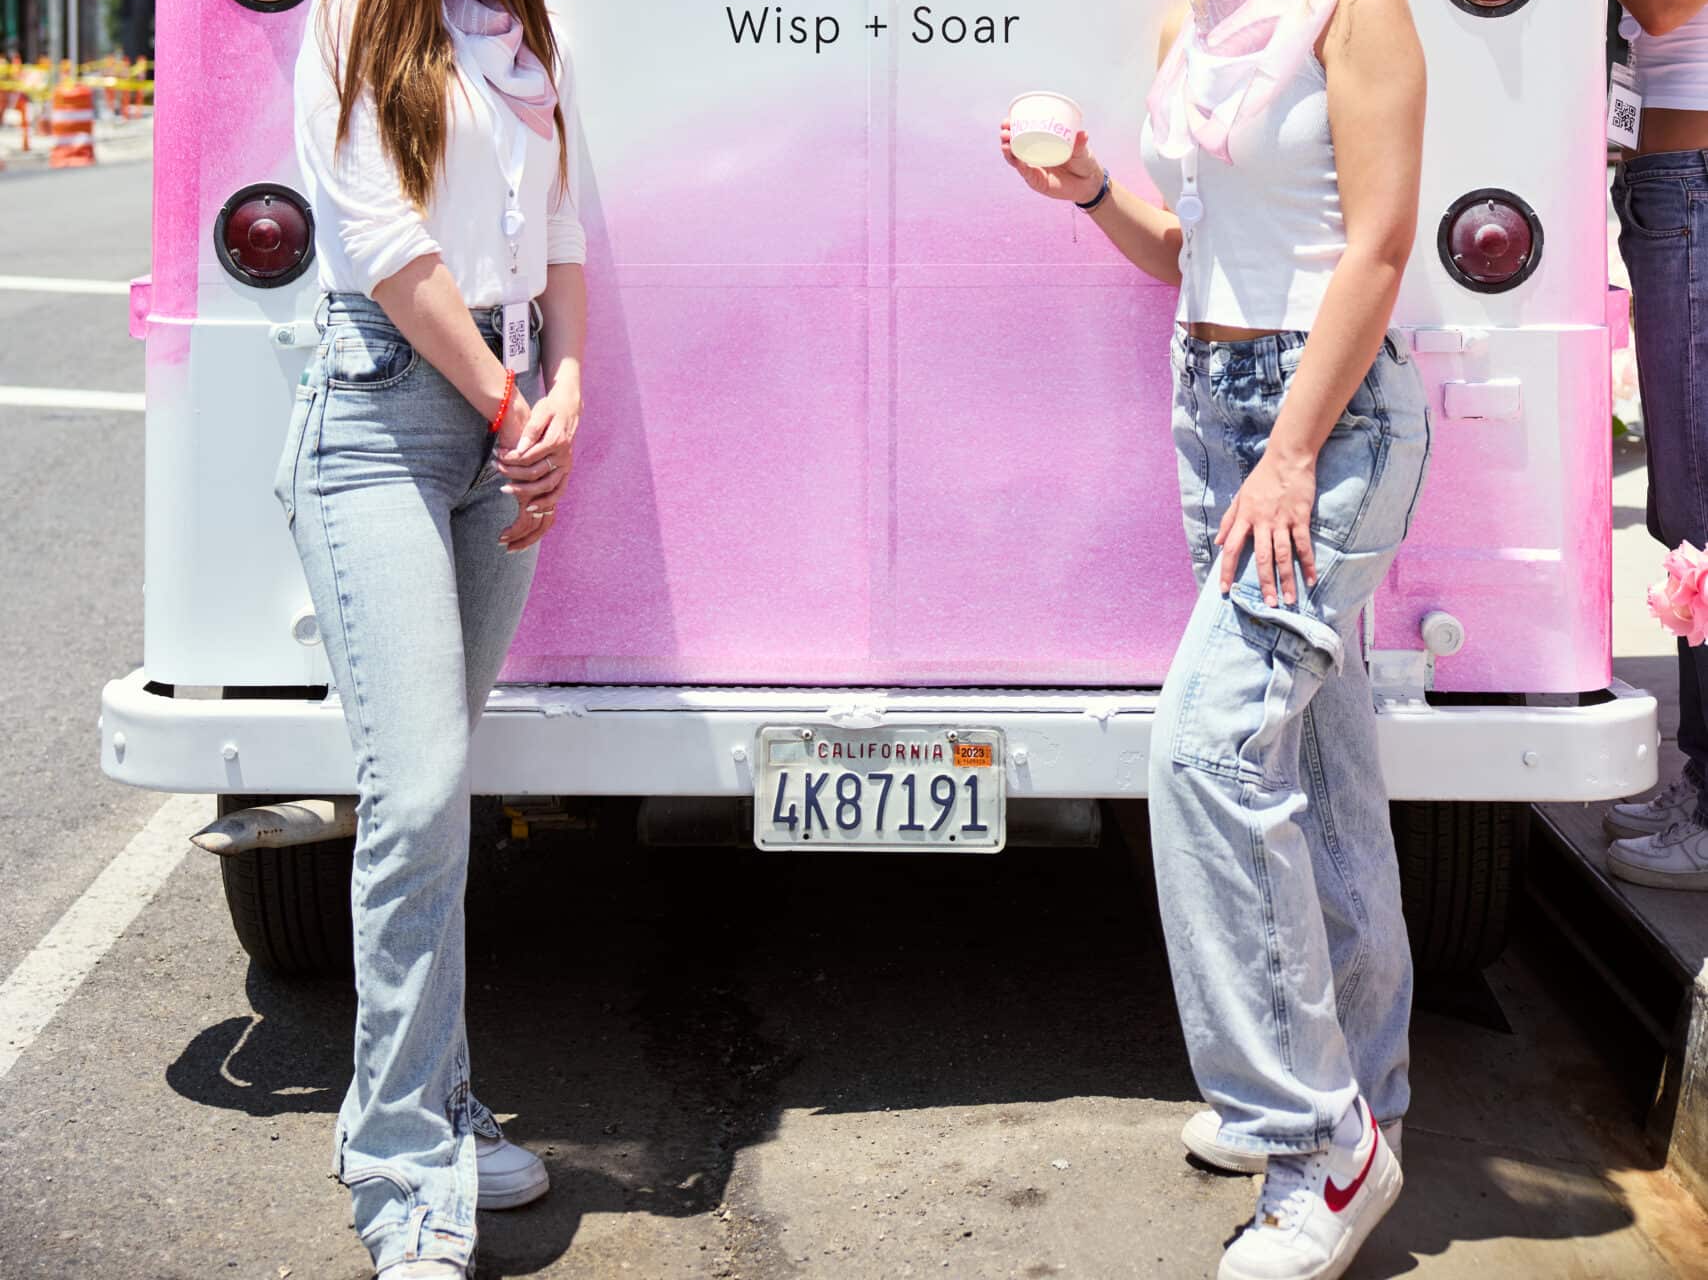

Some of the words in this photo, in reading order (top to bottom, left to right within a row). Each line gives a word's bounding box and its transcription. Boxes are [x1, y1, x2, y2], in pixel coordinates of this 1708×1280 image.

[725, 6, 840, 54] Wisp
[864, 15, 888, 38] +
[911, 5, 1020, 44] Soar
[817, 742, 944, 760] CALIFORNIA
[961, 747, 985, 758] 2023
[772, 771, 988, 832] 4K87191
